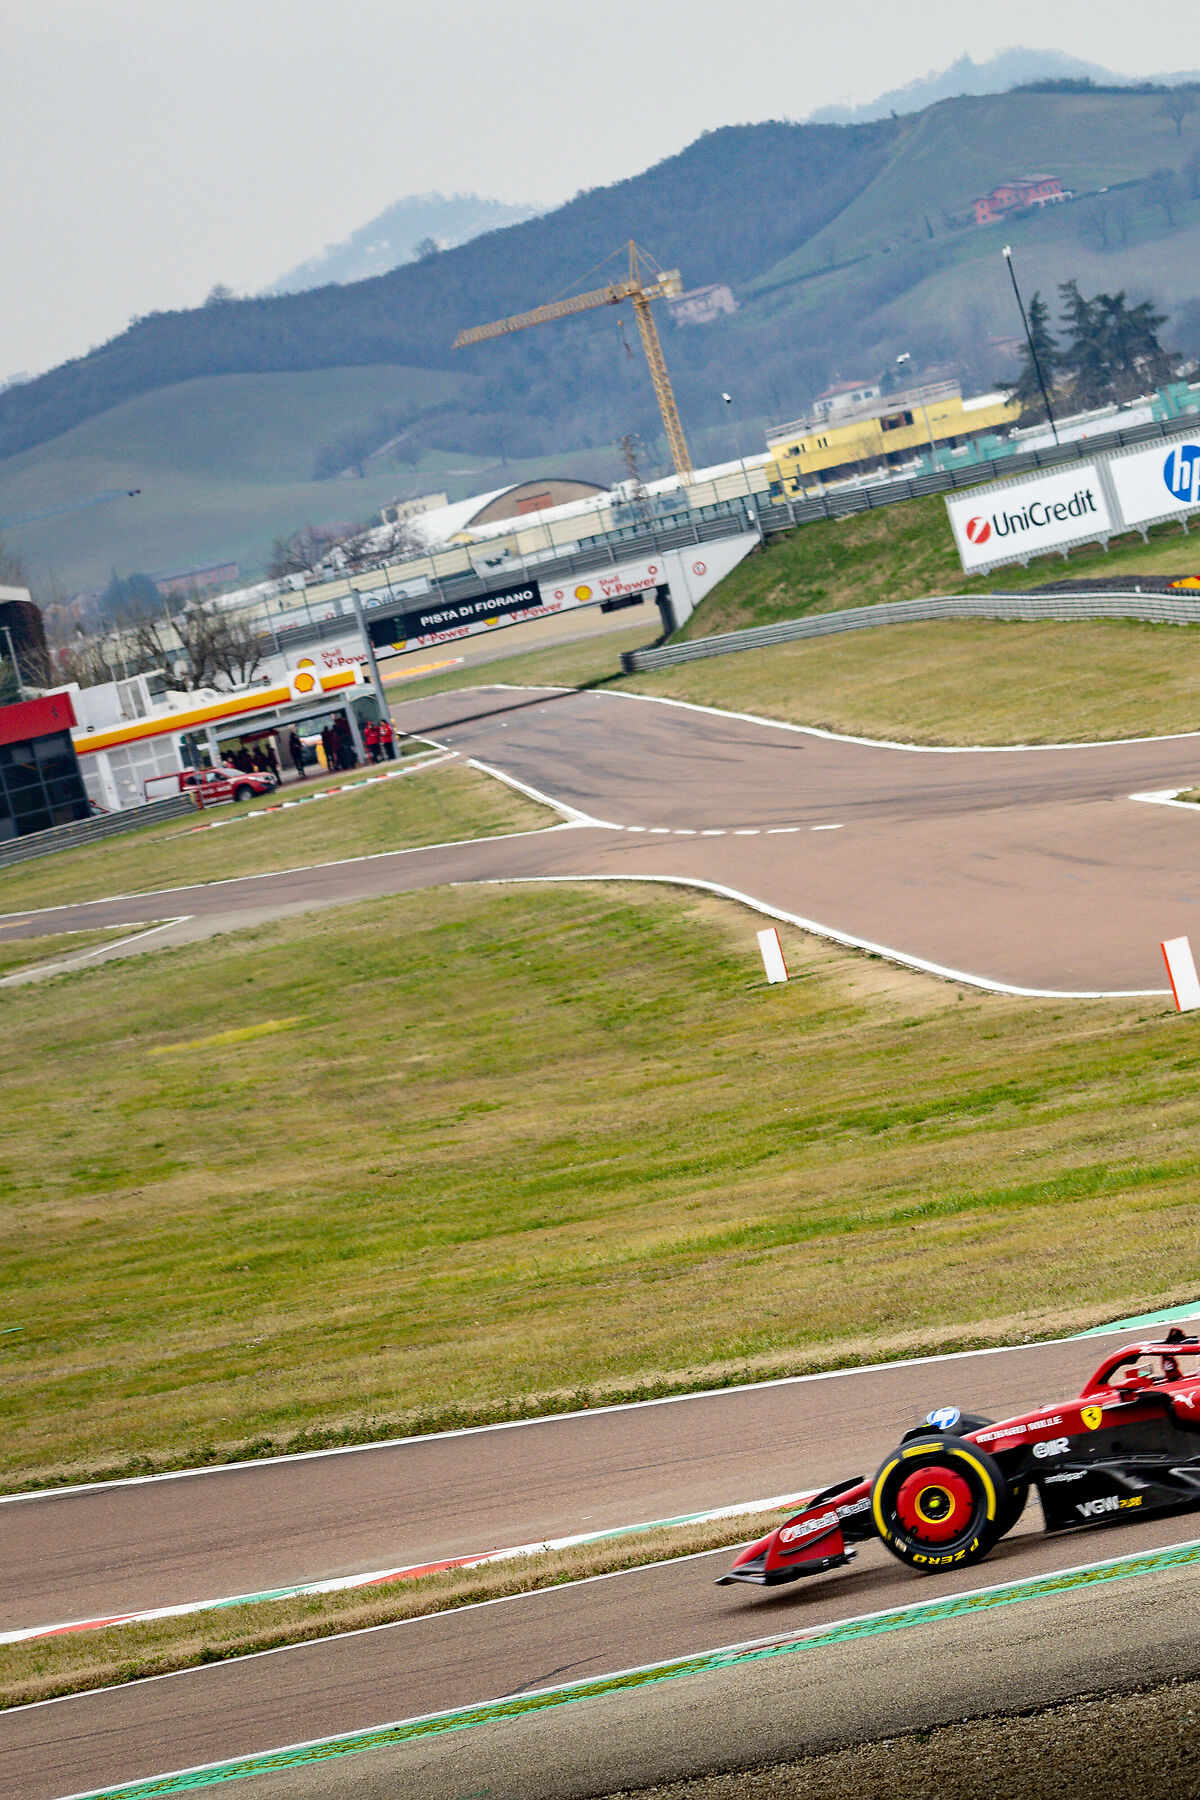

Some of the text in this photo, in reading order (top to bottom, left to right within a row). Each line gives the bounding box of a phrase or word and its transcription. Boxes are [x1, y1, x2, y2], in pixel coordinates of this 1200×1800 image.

[992, 489, 1097, 537] UniCredit
[602, 577, 656, 597] V-Power
[420, 590, 534, 627] PISTA DI FIORANO
[416, 626, 470, 646] V-Power
[913, 1550, 966, 1565] ZERO
